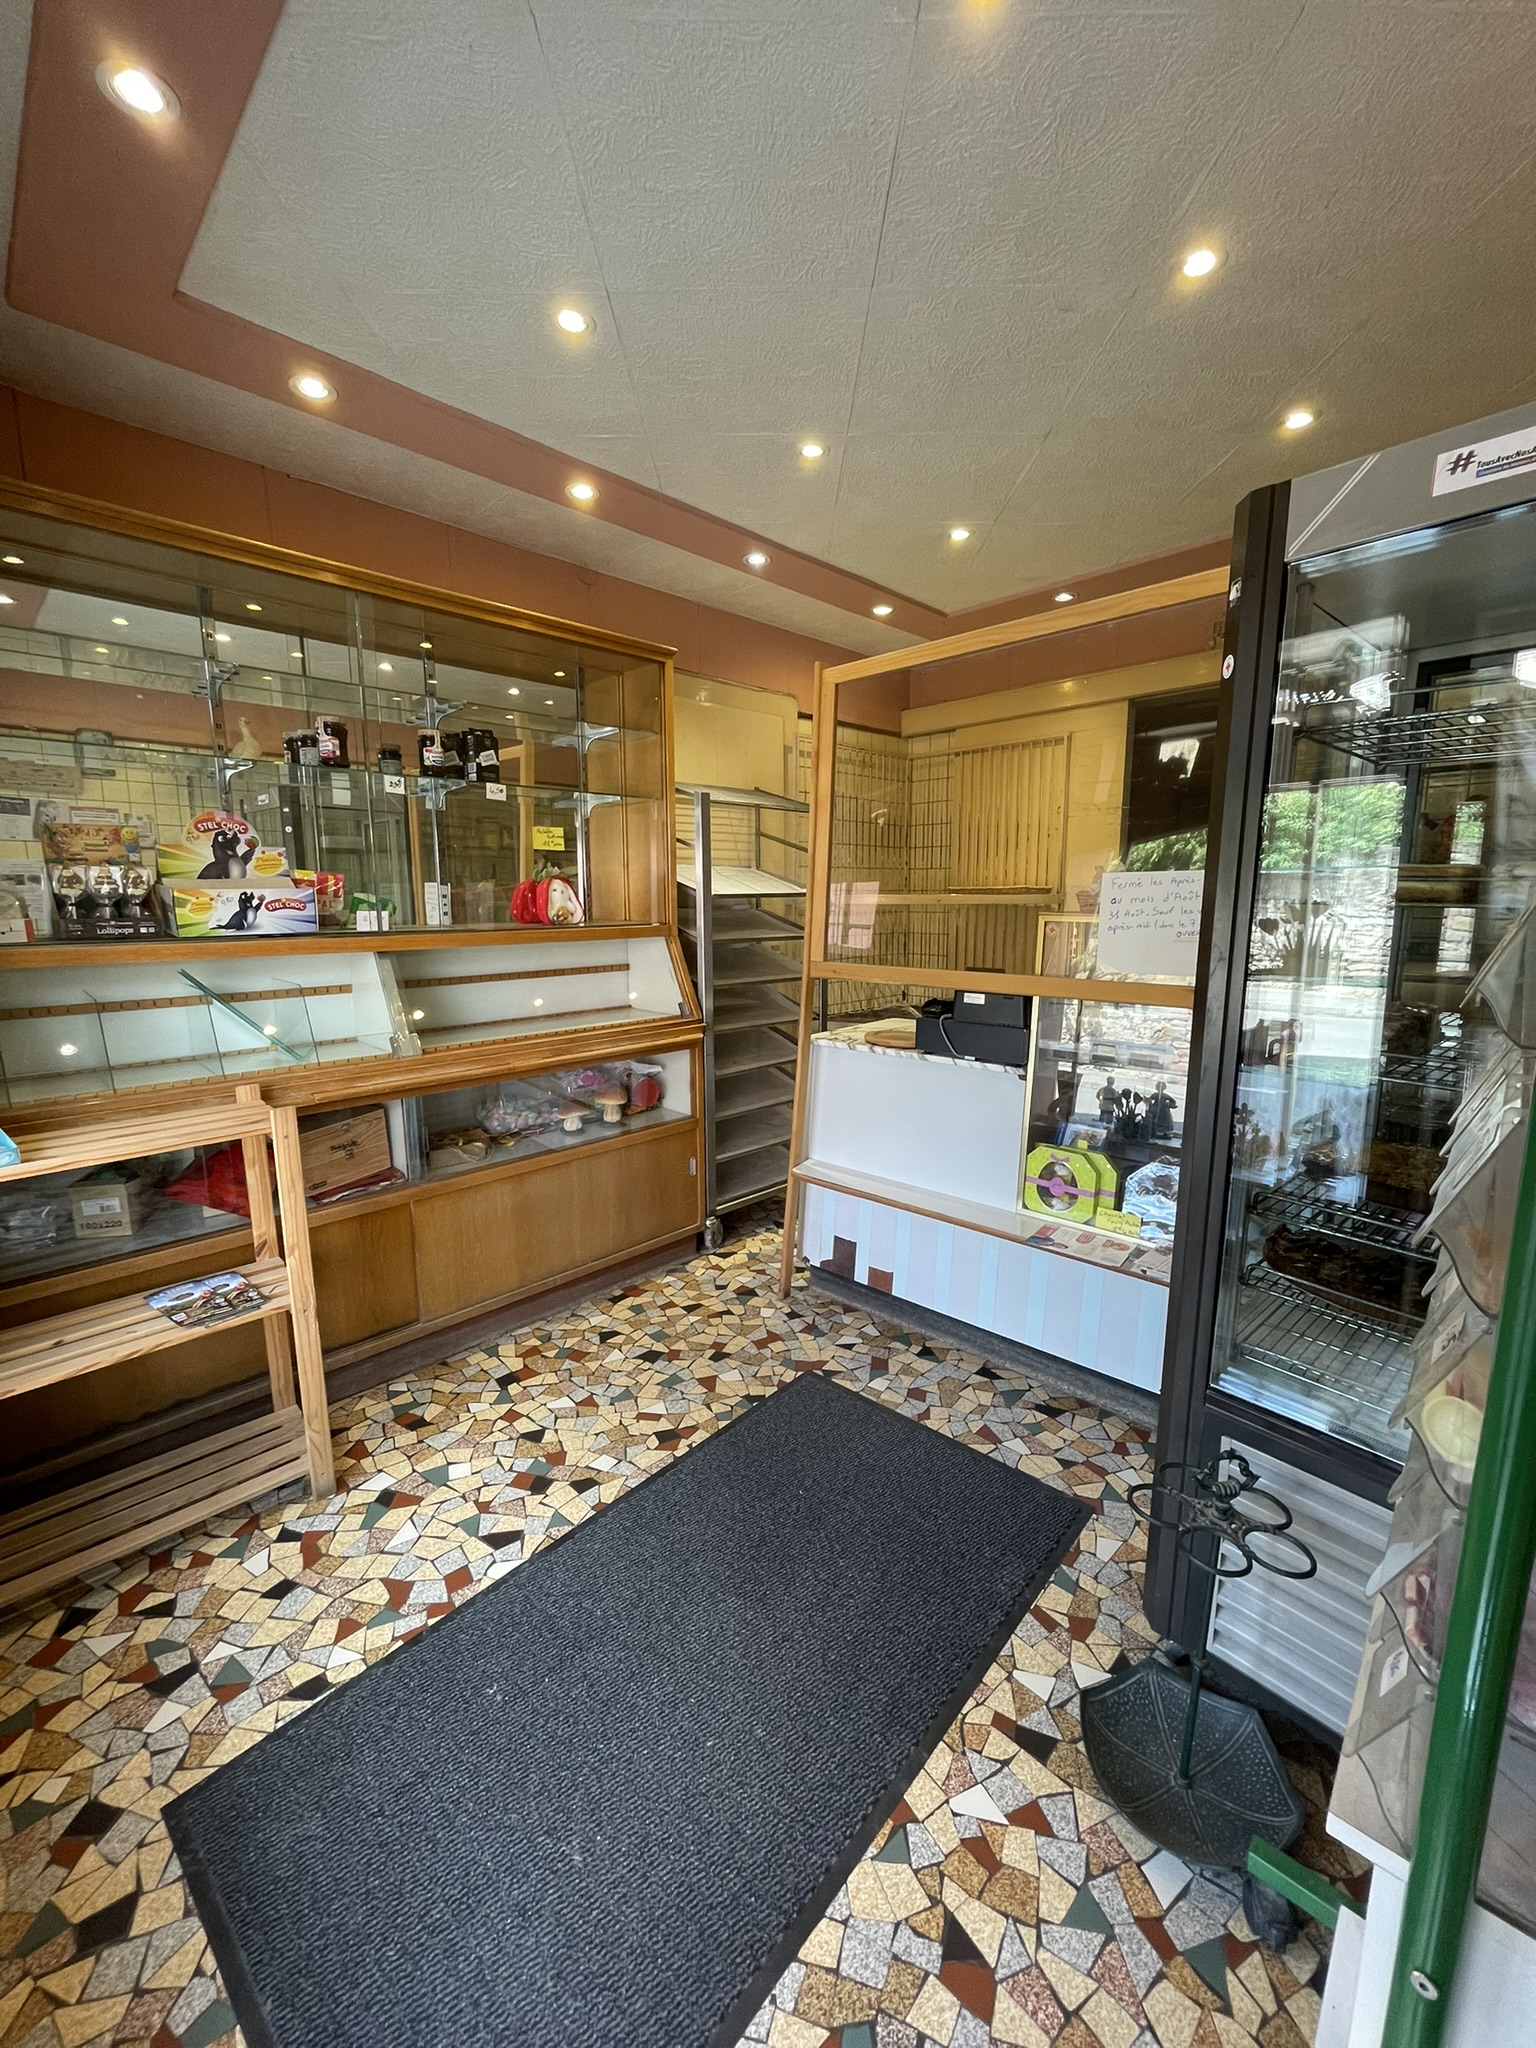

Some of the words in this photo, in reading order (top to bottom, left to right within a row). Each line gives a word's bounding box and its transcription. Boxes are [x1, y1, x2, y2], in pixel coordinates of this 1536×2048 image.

[197, 821, 219, 832] STEL
[221, 821, 246, 833] CHOC
[1111, 877, 1144, 890] Fermé
[1150, 876, 1163, 887] les
[1110, 897, 1122, 905] au
[1130, 896, 1154, 904] mois
[267, 903, 284, 911] STEL
[285, 901, 305, 910] CHOC
[1151, 906, 1175, 916] Sauf
[1180, 906, 1194, 915] les
[96, 927, 134, 935] Lollipops
